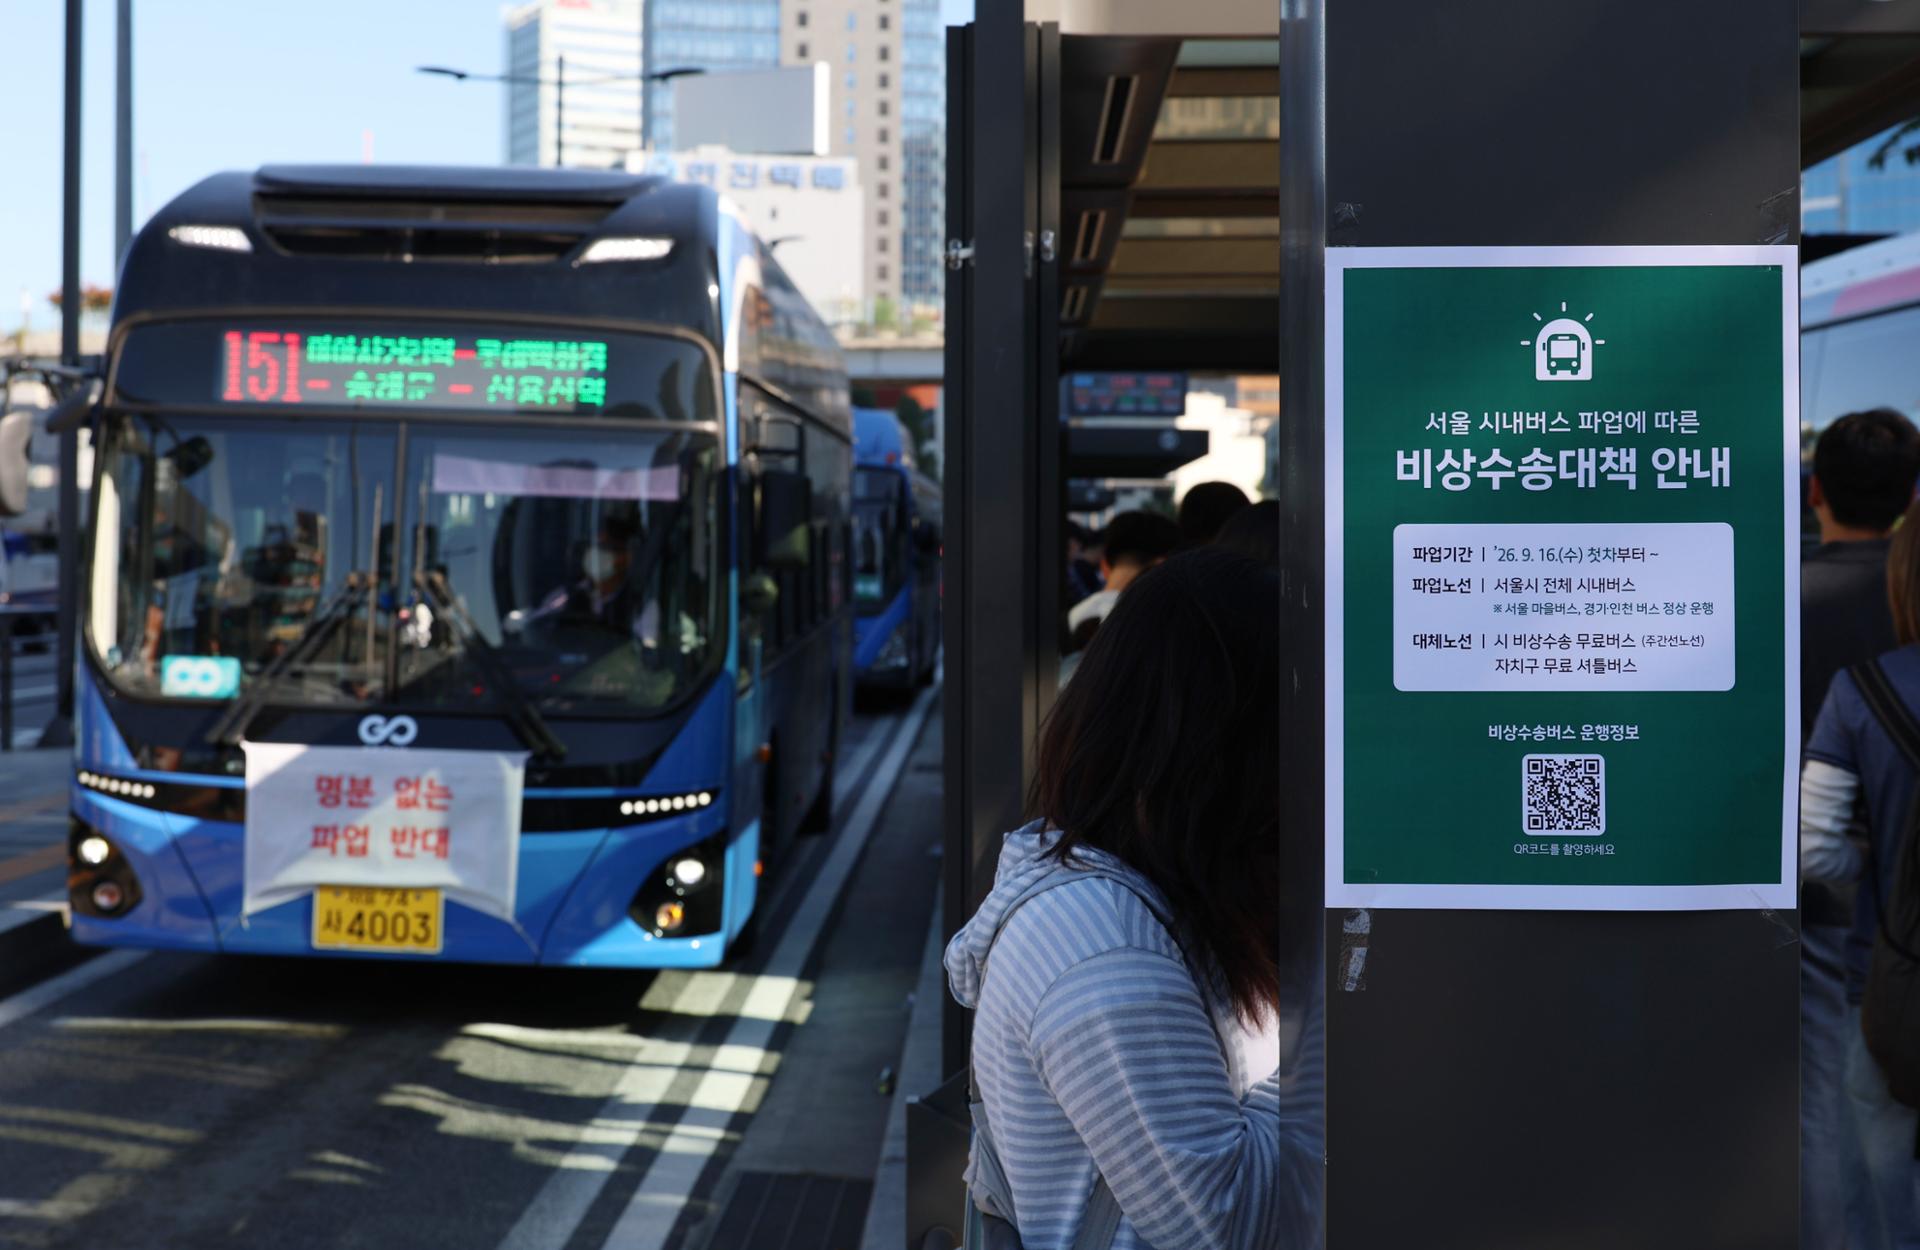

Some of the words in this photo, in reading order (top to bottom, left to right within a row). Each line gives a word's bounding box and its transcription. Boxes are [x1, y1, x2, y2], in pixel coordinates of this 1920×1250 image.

[224, 331, 301, 402] 151
[1425, 410, 1472, 436] 서울
[1478, 410, 1571, 435] 시내버스
[1578, 410, 1646, 435] 파업에
[1654, 410, 1701, 434] 따른
[1396, 446, 1637, 492] 비상수송대책
[1651, 446, 1731, 489] 안내
[1412, 546, 1474, 563] 파업기간
[1538, 546, 1584, 565] 16.(수)
[1587, 546, 1645, 564] 첫차부터
[1412, 577, 1472, 594] 파업노선
[1493, 576, 1539, 594] 서울시
[1543, 577, 1572, 594] 전체
[1576, 577, 1636, 594] 시내버스
[1504, 602, 1530, 616] 서울
[1636, 602, 1661, 615] 버스
[1662, 601, 1688, 616] 정상
[1689, 601, 1714, 616] 운행
[1412, 633, 1472, 650] 대체노선
[1493, 633, 1508, 650] 시
[1513, 632, 1573, 651] 비상수송
[1575, 633, 1637, 650] 무료버스
[1641, 634, 1705, 648] (주간선노선)
[1495, 657, 1540, 675] 자치구
[1543, 658, 1574, 675] 무료
[1576, 657, 1638, 675] 셔틀버스
[1488, 724, 1577, 742] 비상수송버스
[1579, 724, 1640, 742] 운행정보
[315, 775, 375, 809] 명분
[393, 776, 453, 812] 없는
[310, 824, 371, 858] 파업
[389, 826, 451, 860] 반대
[1513, 843, 1561, 856] QR코드를
[1562, 843, 1616, 857] 촬영하세요
